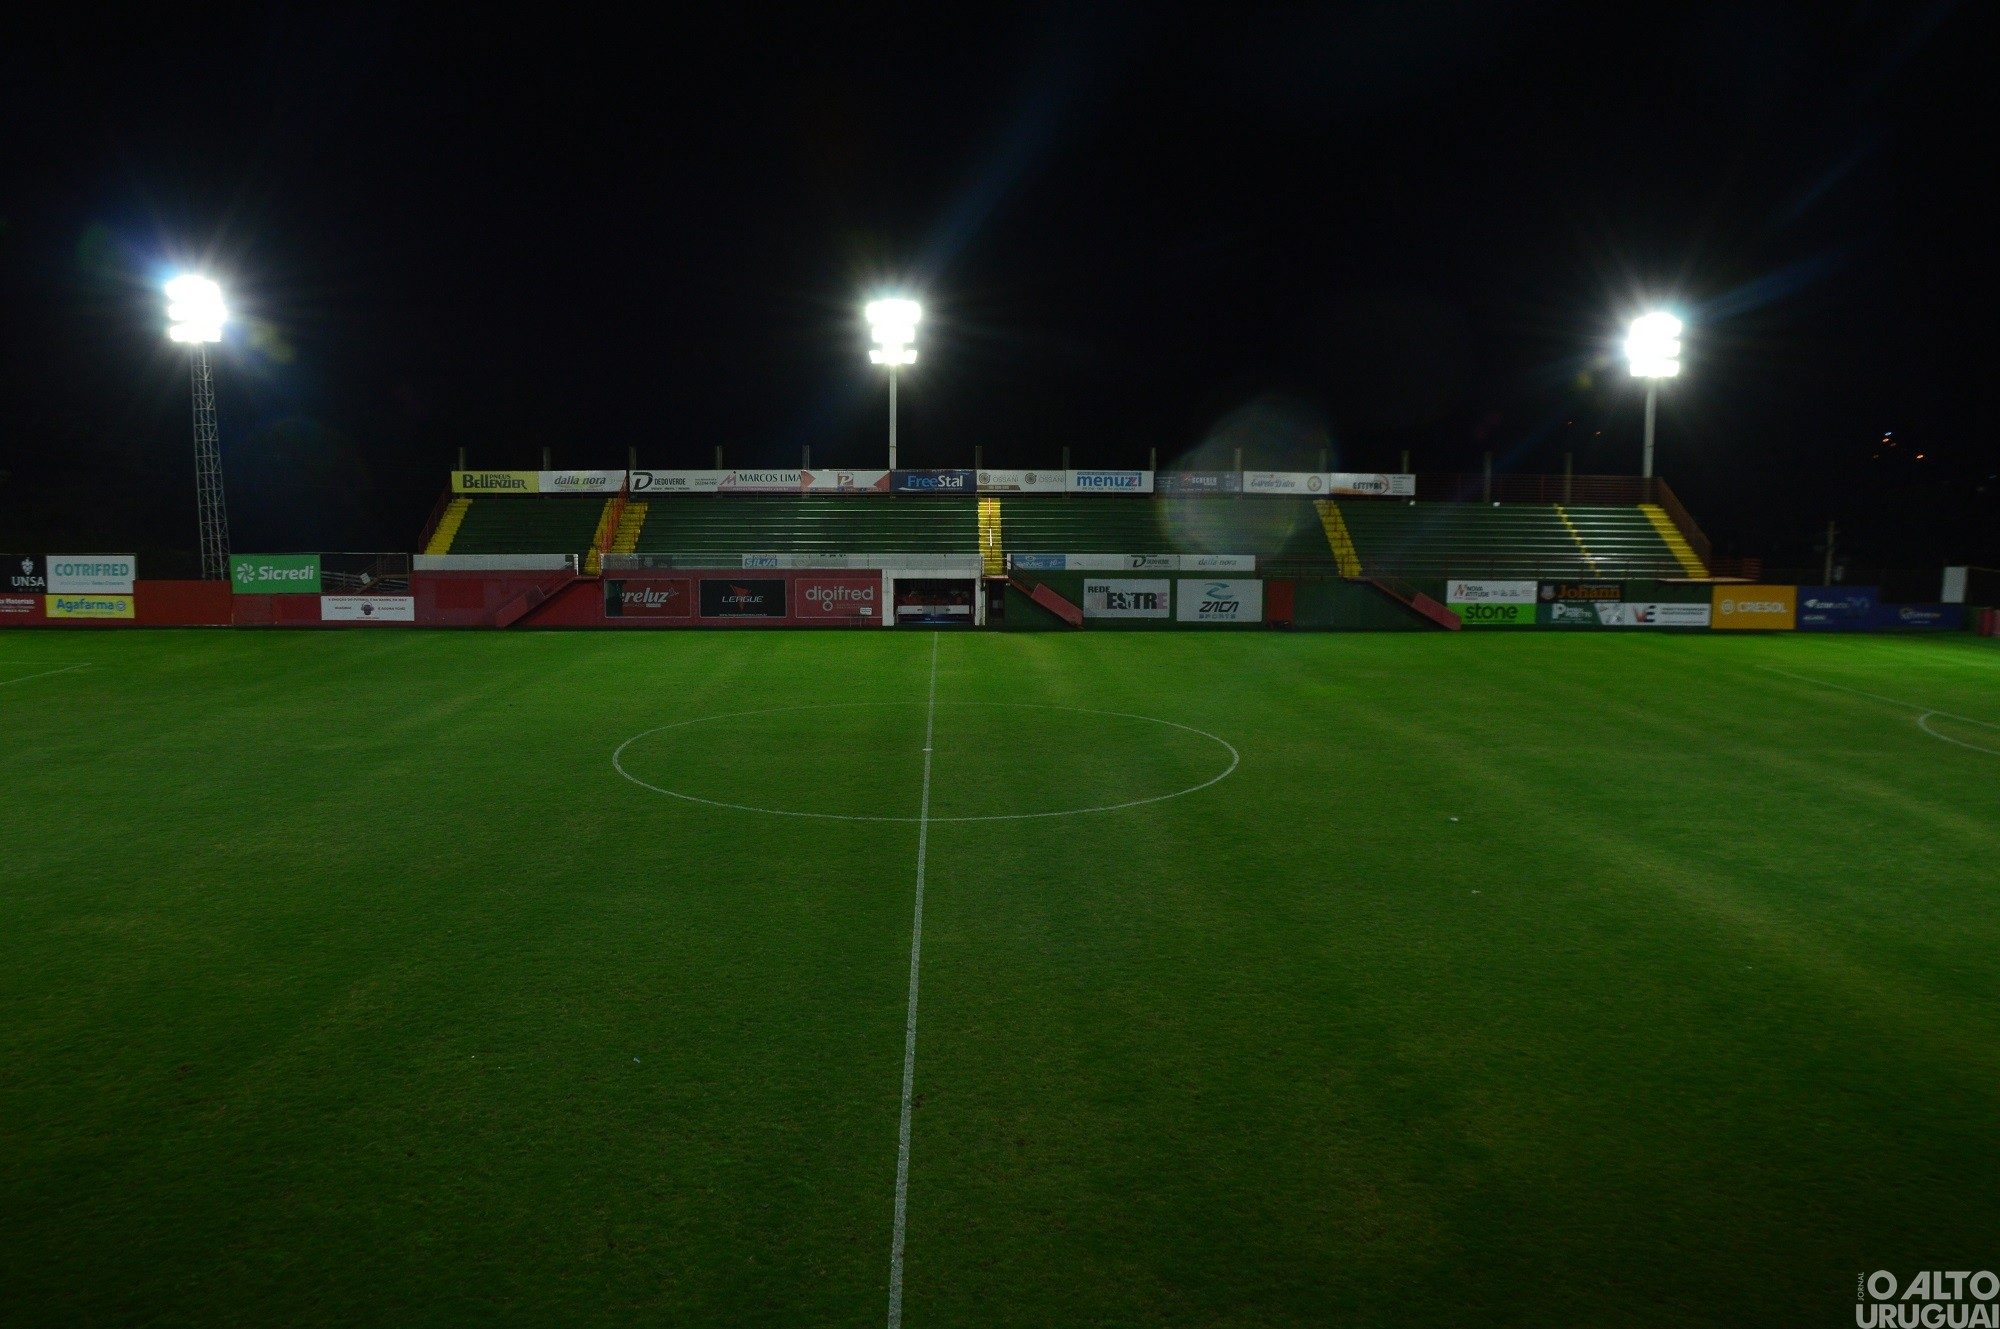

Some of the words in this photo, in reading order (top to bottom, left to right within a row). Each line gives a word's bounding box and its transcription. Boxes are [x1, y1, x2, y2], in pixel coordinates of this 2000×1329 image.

[739, 474, 778, 483] MARCOS
[781, 474, 802, 483] LIMA
[907, 475, 963, 487] FreeStal
[54, 563, 129, 576] COTRIFRED
[258, 565, 314, 581] Sicredi
[12, 576, 46, 587] UNSA
[1088, 586, 1111, 594] REDE
[722, 595, 764, 603] LEAGUE
[805, 586, 874, 611] digifred
[57, 599, 114, 612] Agafarma
[1465, 603, 1518, 619] stone
